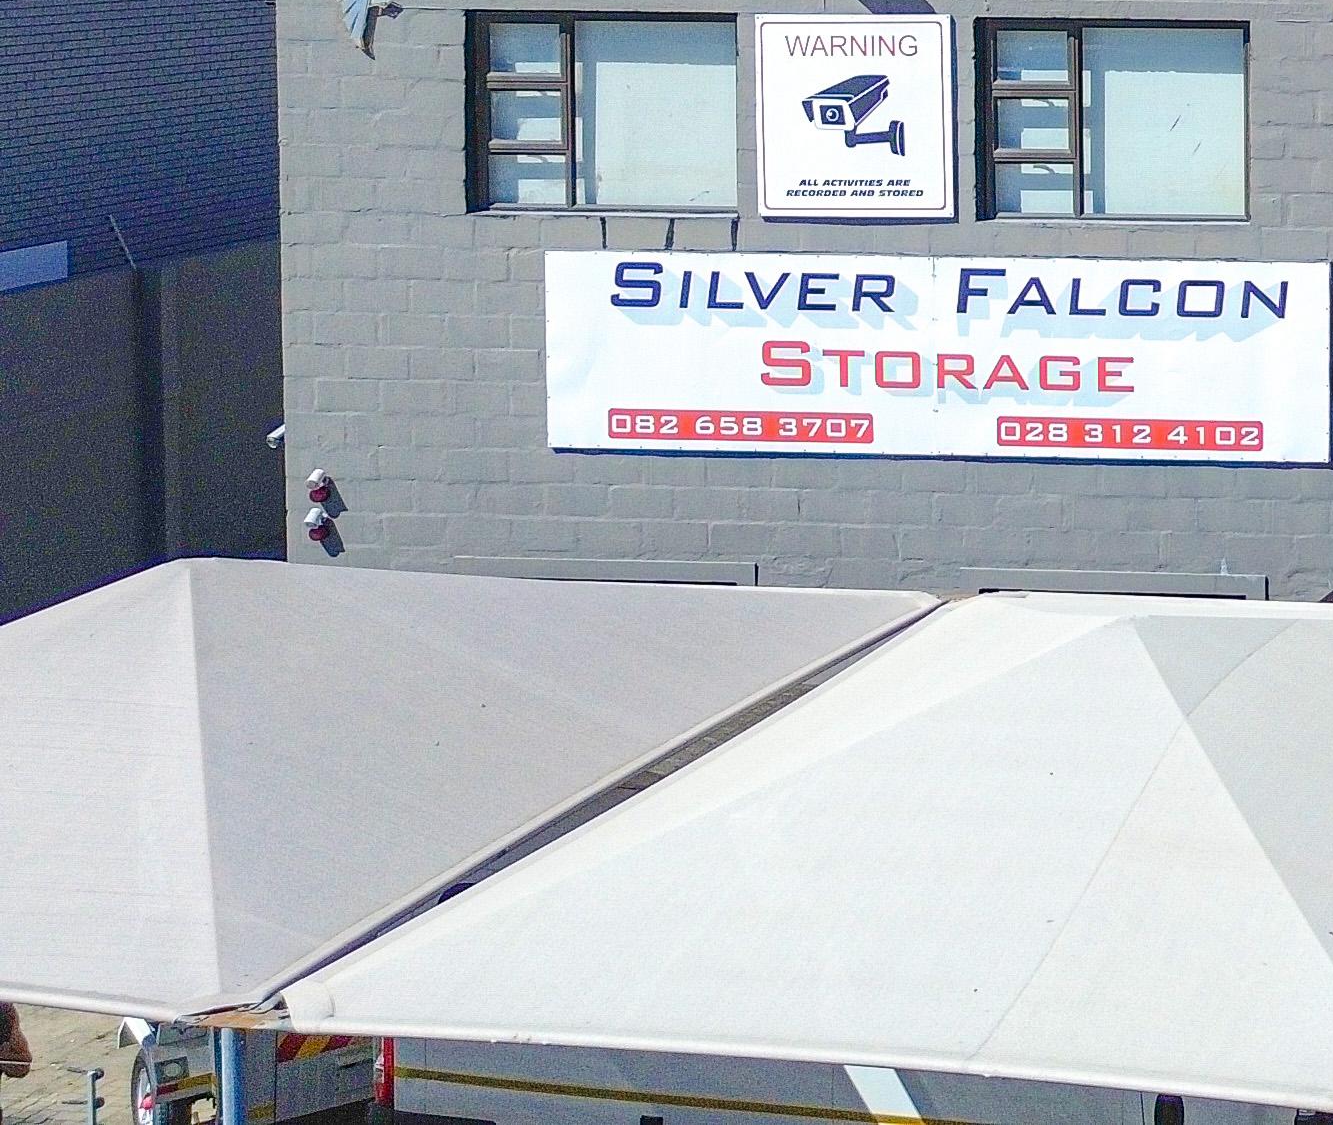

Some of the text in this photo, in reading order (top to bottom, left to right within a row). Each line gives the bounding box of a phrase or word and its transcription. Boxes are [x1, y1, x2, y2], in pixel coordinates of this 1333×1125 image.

[785, 35, 918, 57] WARNING
[786, 189, 924, 197] RECORDED AND STORED
[799, 179, 911, 187] ALL ACTIVITIES ARE
[611, 262, 1289, 319] SILVER FALCON
[761, 341, 1135, 393] STORAGE
[611, 414, 870, 438] 082 658 3707
[1000, 422, 1260, 446] 028 312 4102
